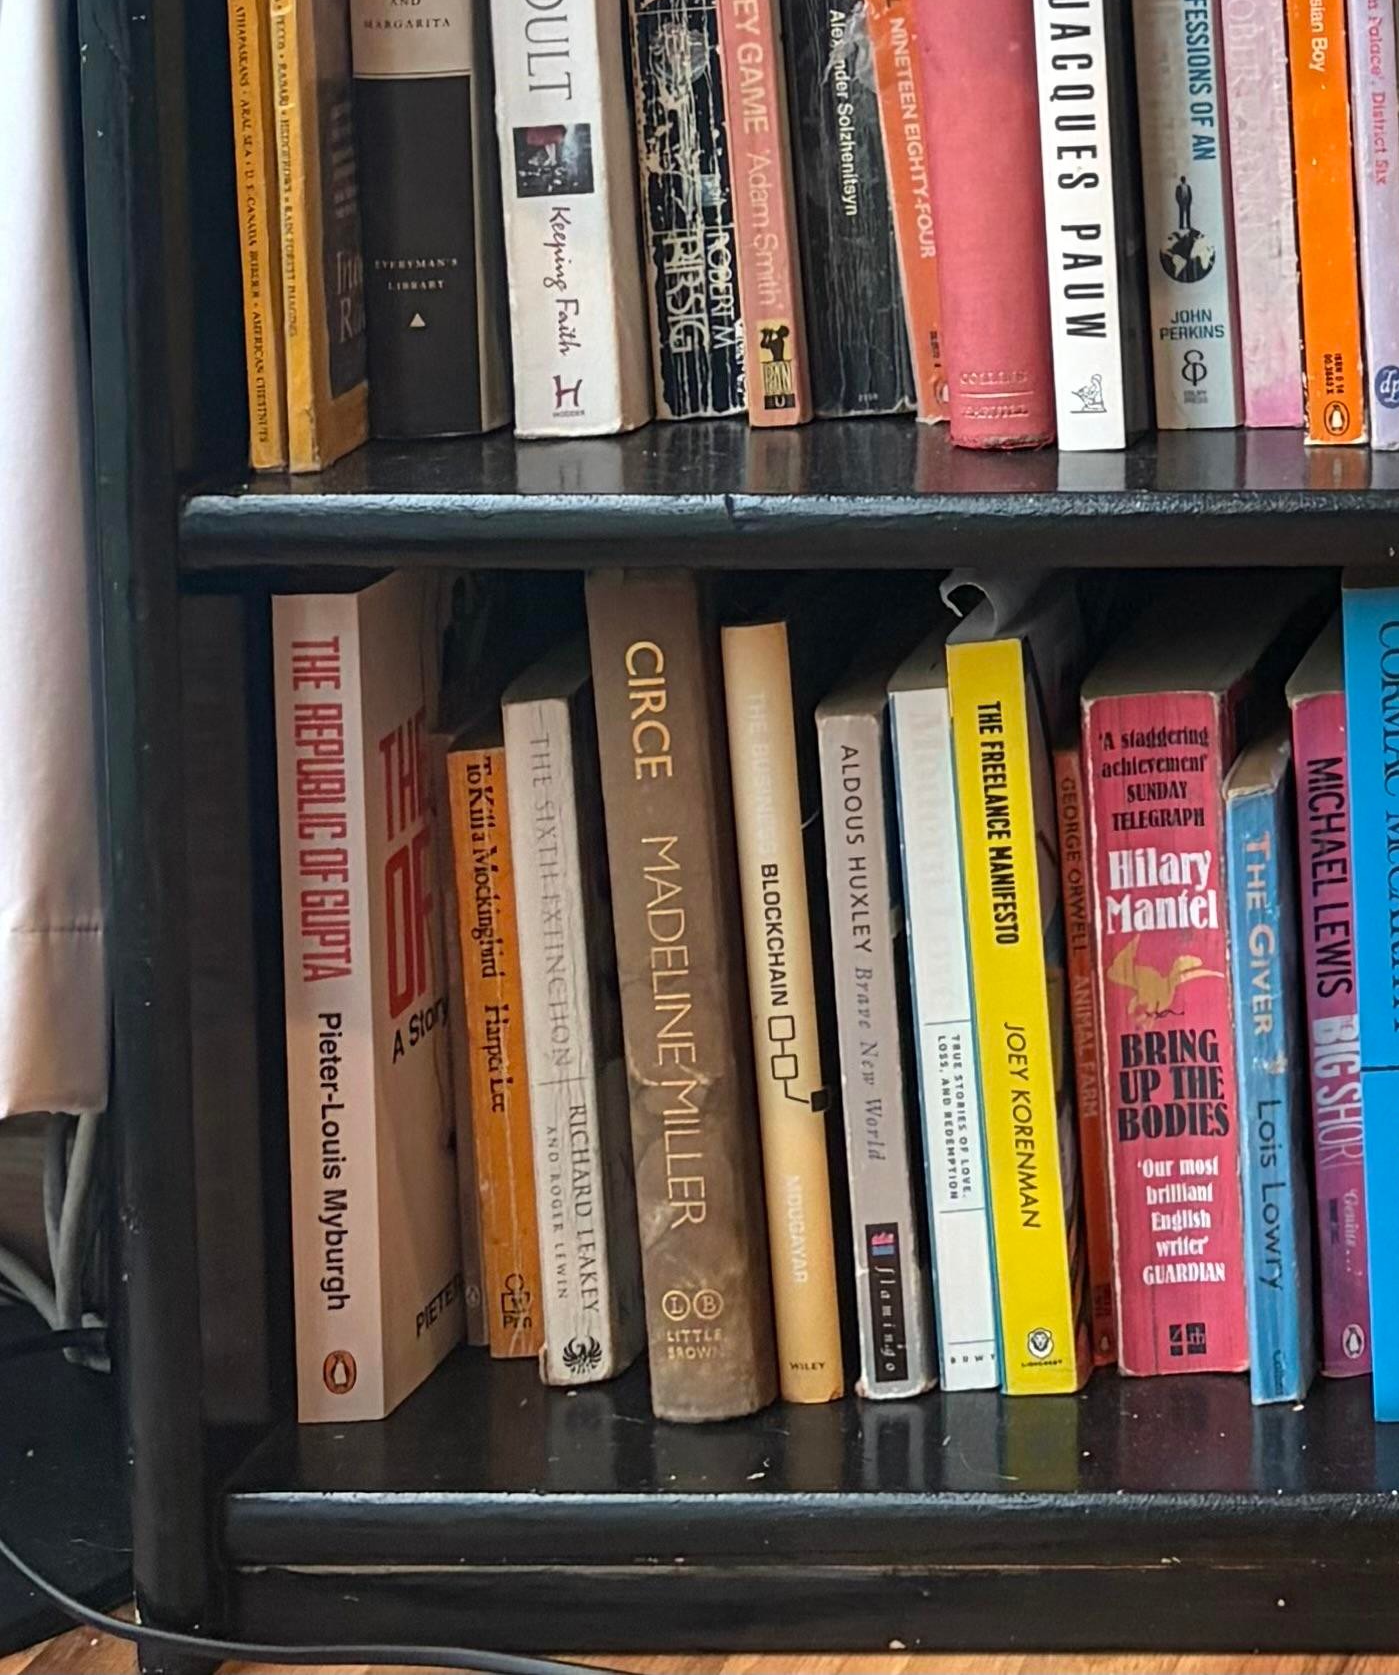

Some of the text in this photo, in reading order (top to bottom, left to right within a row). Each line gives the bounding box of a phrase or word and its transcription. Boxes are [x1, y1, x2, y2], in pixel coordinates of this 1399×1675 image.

[1061, 224, 1107, 339] PAUW
[1160, 326, 1224, 340] PERKINS
[1171, 310, 1212, 324] JOHN
[625, 641, 672, 779] CIRCE
[294, 704, 351, 982] REPUBLIC OF GUPTA
[841, 745, 872, 953] ALDOUS HUXLEY
[981, 741, 1019, 945] FREELANCE MANIFESTO
[1307, 758, 1353, 999] MICHAEL LEWIS
[761, 863, 788, 1007] BLOCKCHAIN
[1122, 1030, 1219, 1067] BRING
[318, 1012, 350, 1311] Pieter-Louis Myburgh
[1119, 1102, 1230, 1142] BODIES
[1142, 1264, 1226, 1286] GUARDIAN
